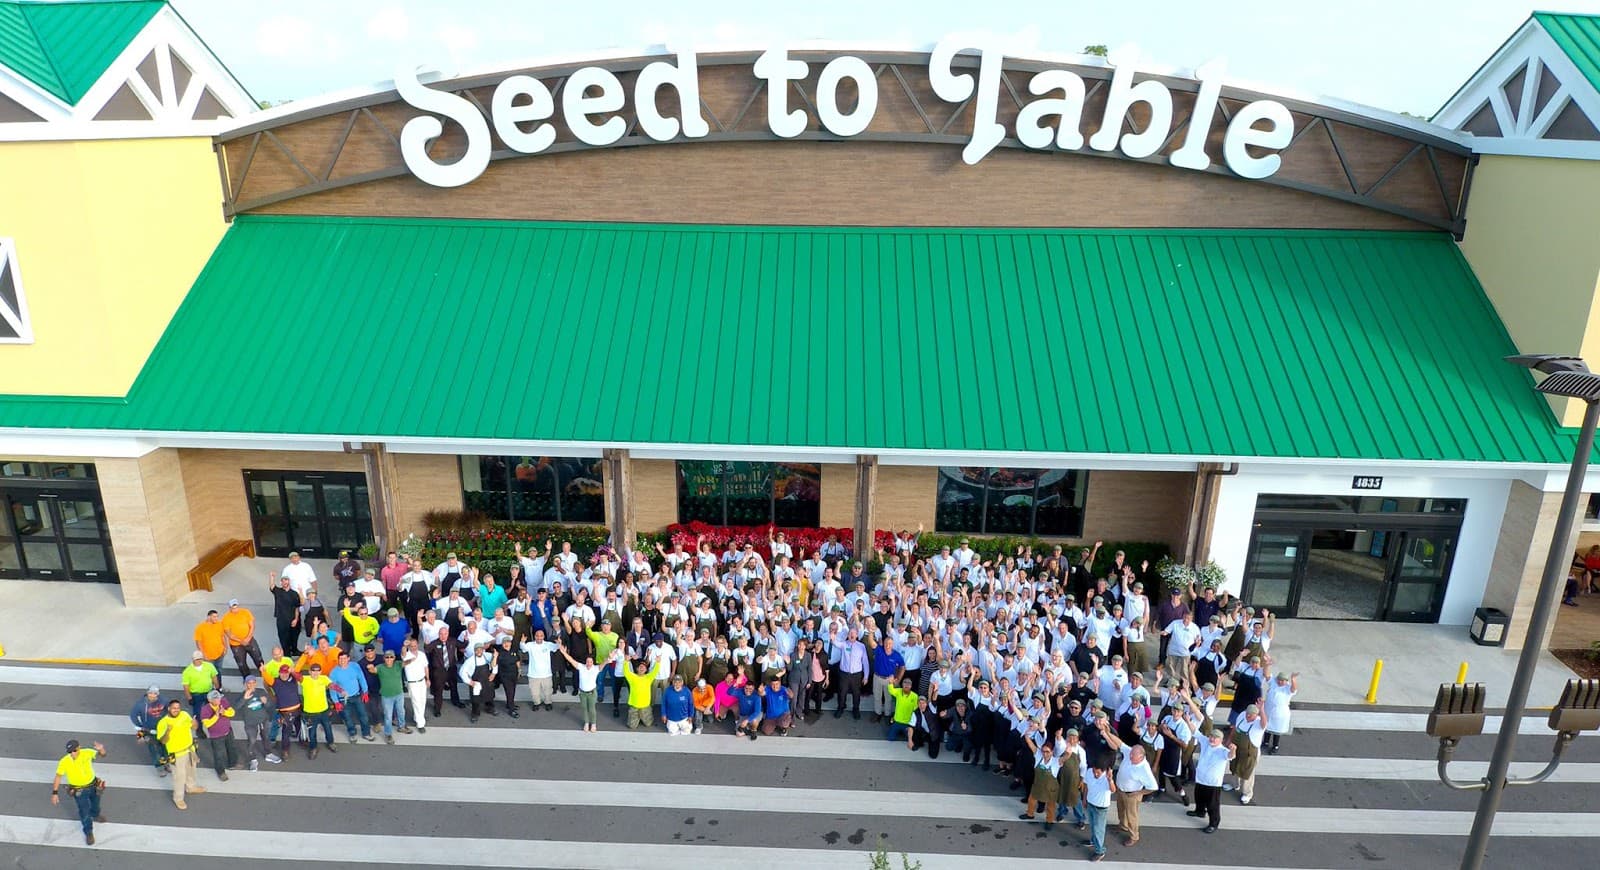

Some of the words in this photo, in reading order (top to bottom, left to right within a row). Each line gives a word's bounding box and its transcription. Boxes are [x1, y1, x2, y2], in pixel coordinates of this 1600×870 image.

[393, 42, 709, 188] Seed
[753, 46, 878, 137] to
[929, 30, 1295, 179] Table
[1354, 478, 1380, 488] 4835
